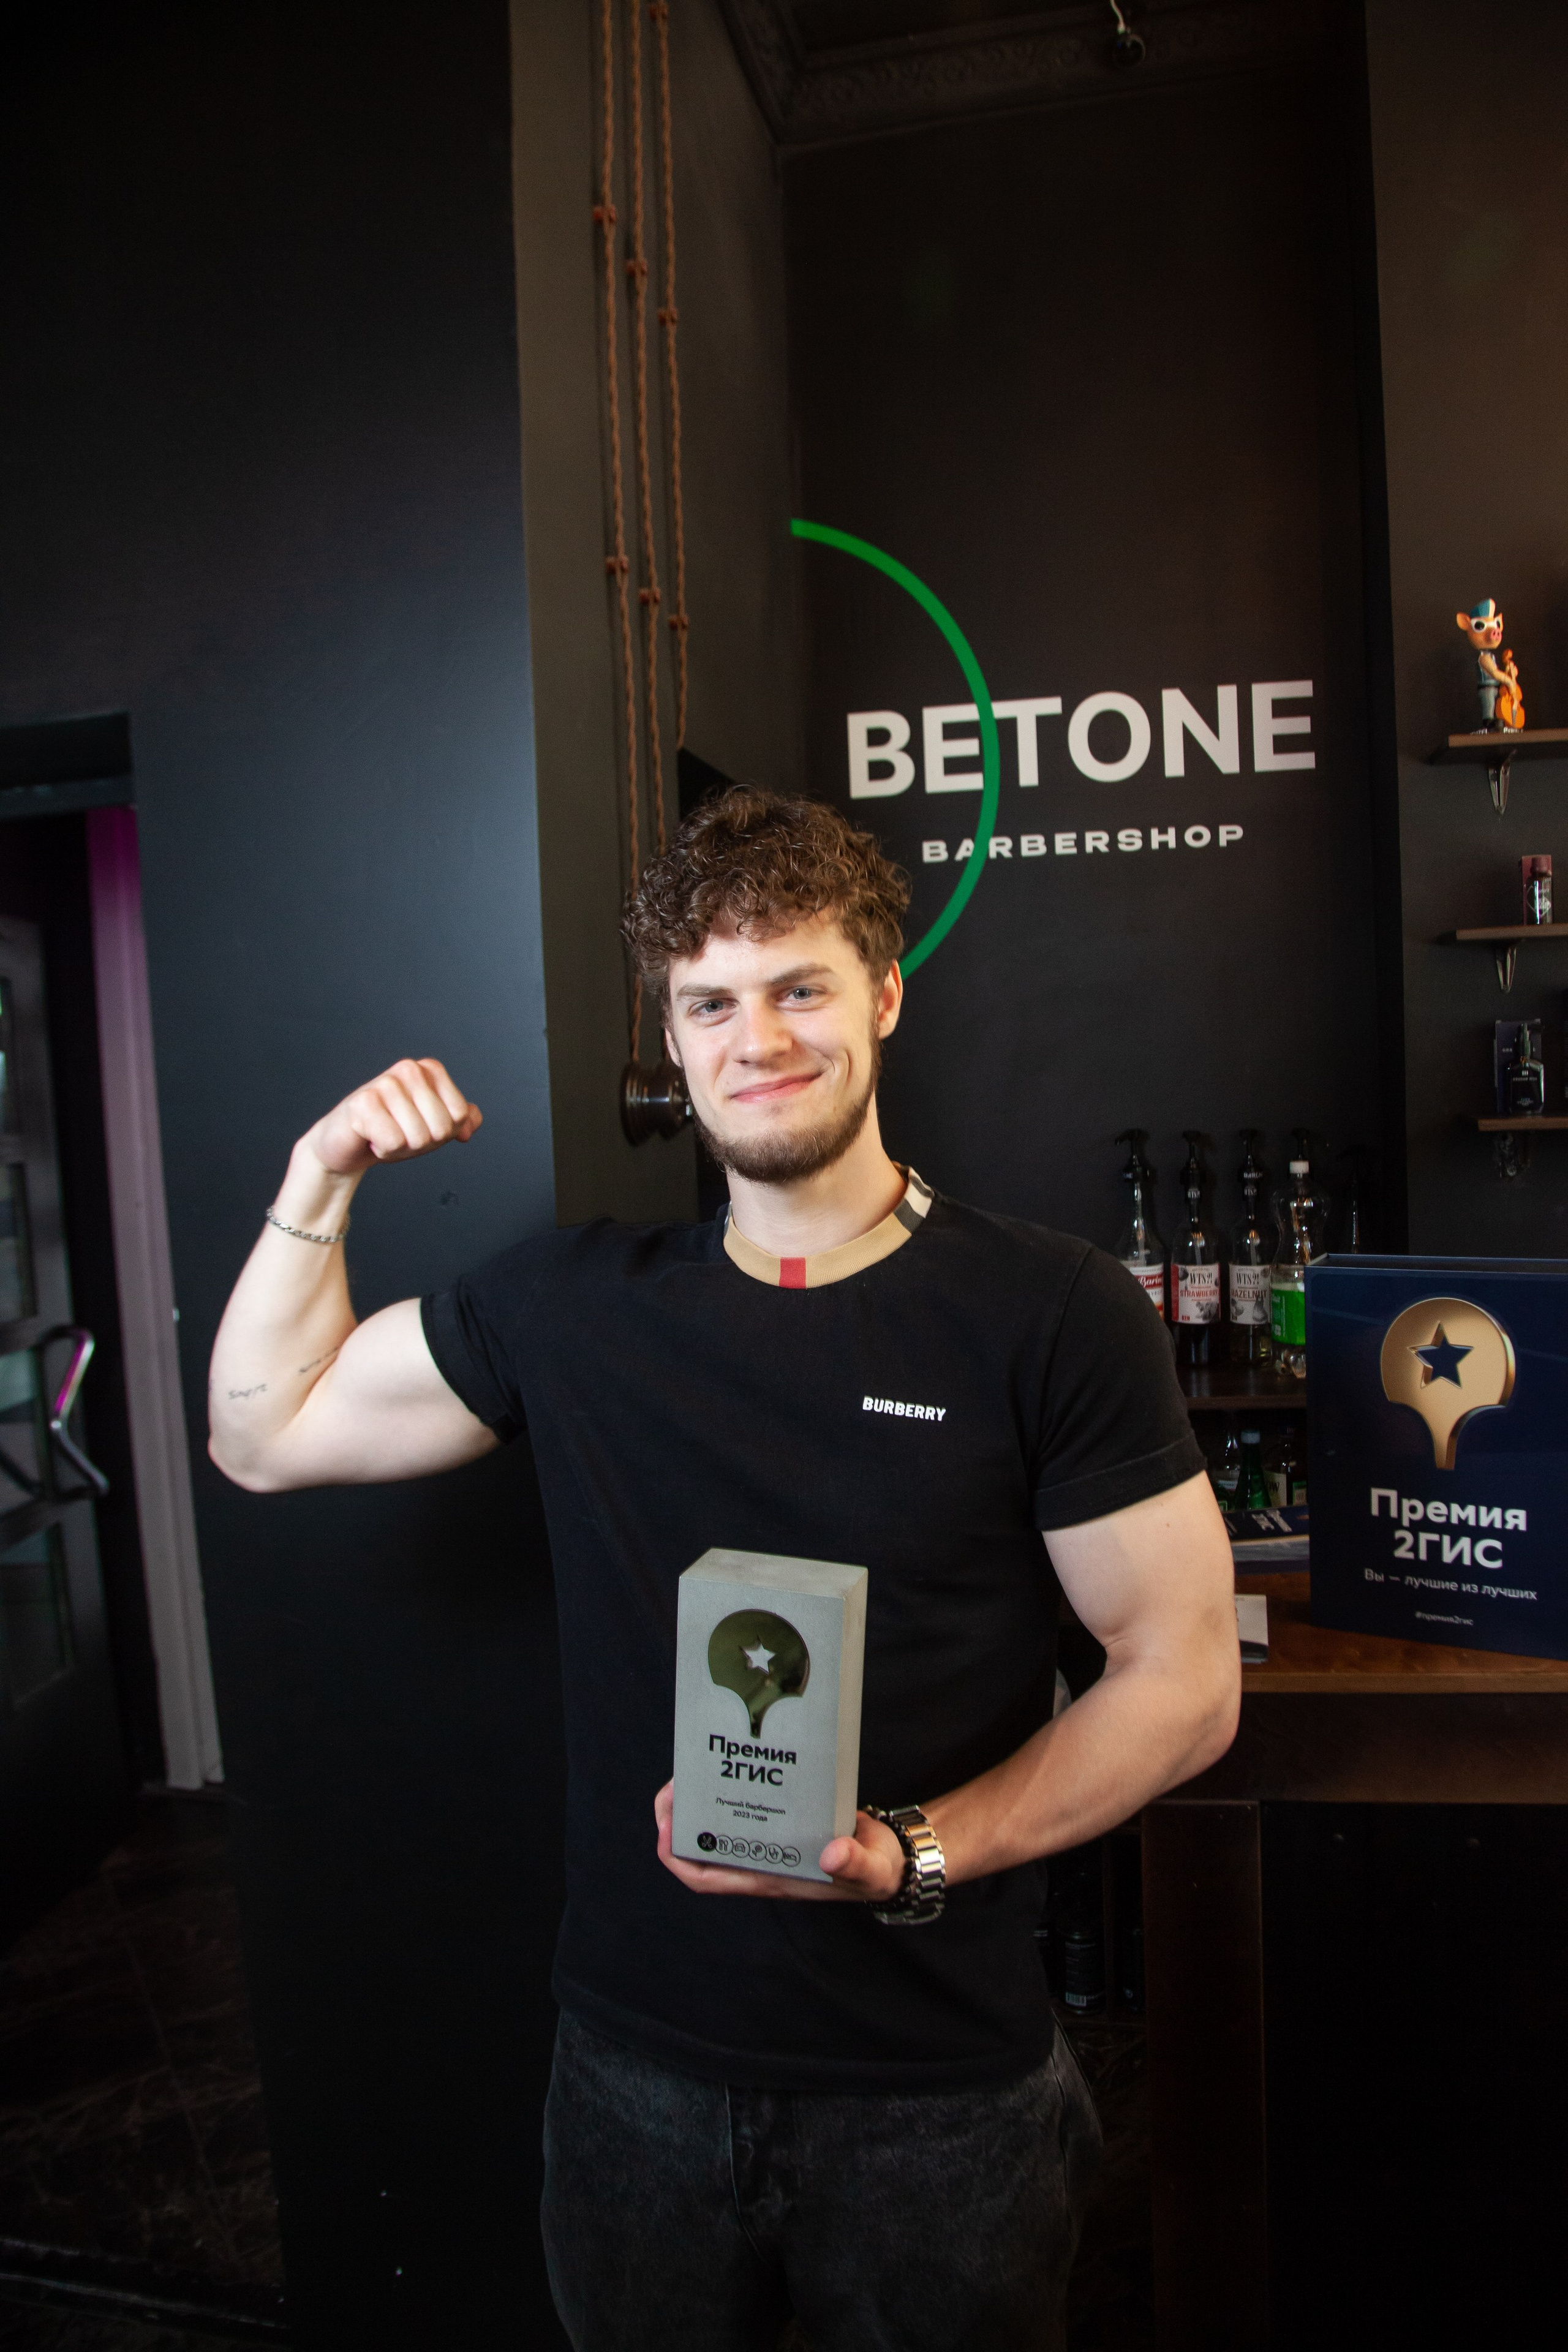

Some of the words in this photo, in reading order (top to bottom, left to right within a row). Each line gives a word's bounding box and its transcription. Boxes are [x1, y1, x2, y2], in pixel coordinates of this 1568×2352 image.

[847, 680, 1316, 799] BETONE
[922, 824, 1244, 863] BARBERSHOP
[1180, 1289, 1218, 1298] STRAWBERRY
[1231, 1289, 1267, 1298] HAZELNUT
[862, 1396, 946, 1422] BURBERRY
[1371, 1487, 1527, 1532] Премия
[1393, 1529, 1503, 1569] 2ГИС
[1363, 1568, 1384, 1582] Вы
[1405, 1575, 1458, 1591] лучшие
[1461, 1583, 1479, 1593] из
[1481, 1585, 1537, 1600] лучших
[709, 1734, 797, 1765] Премия
[720, 1760, 783, 1786] 2ГИС
[715, 1797, 744, 1808] Лучший
[745, 1802, 786, 1815] барбершоп
[733, 1809, 750, 1819] 2023
[751, 1814, 768, 1822] года
